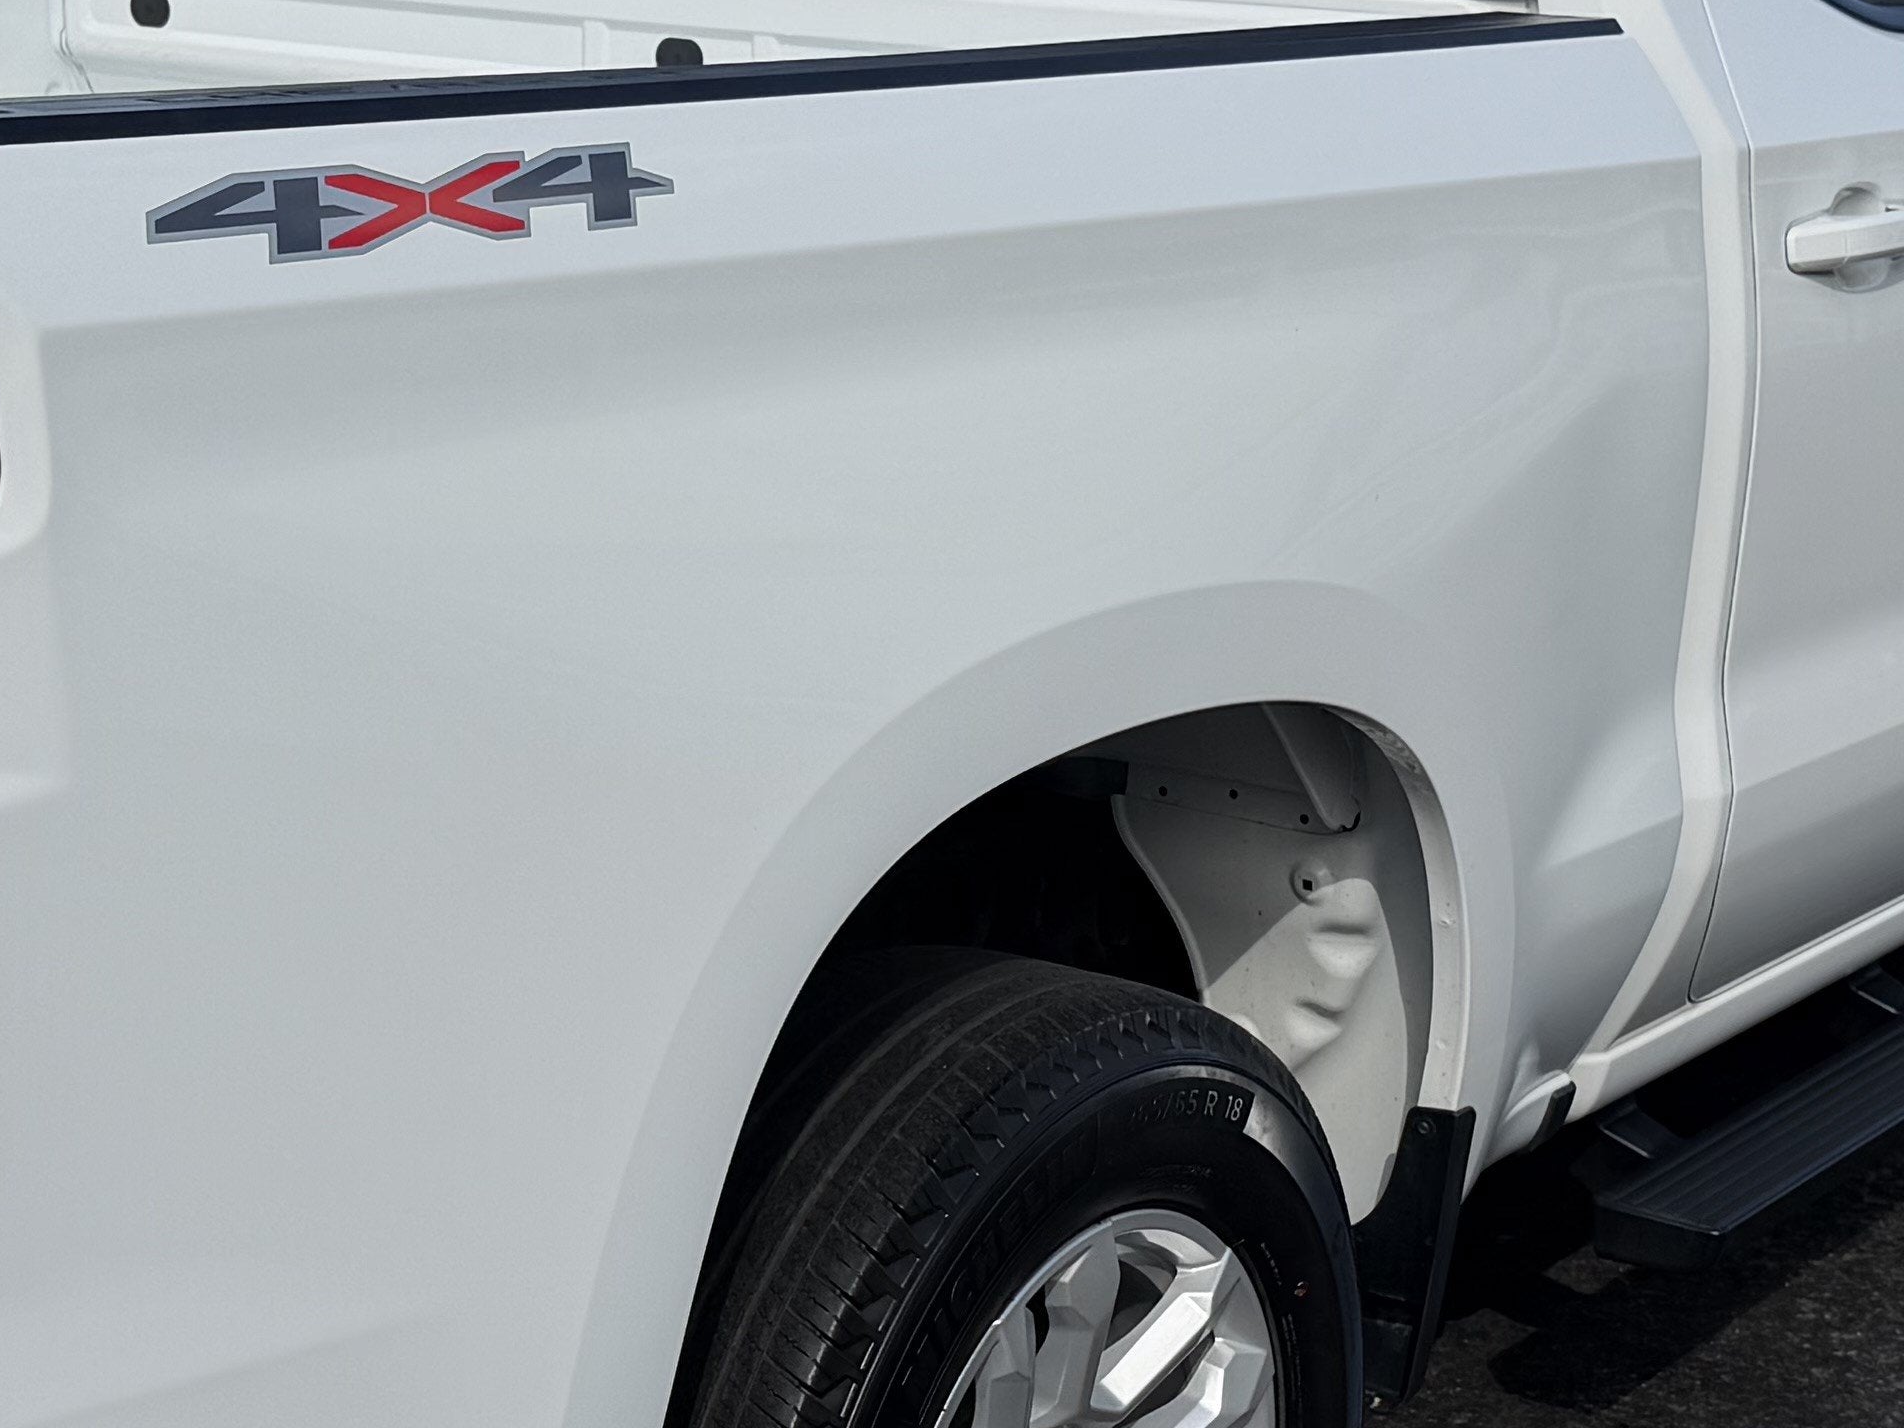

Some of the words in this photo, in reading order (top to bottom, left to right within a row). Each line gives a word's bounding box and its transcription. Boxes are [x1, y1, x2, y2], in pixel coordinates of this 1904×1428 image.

[146, 141, 675, 266] 4X4
[1203, 1090, 1219, 1117] R
[1223, 1095, 1244, 1122] 18
